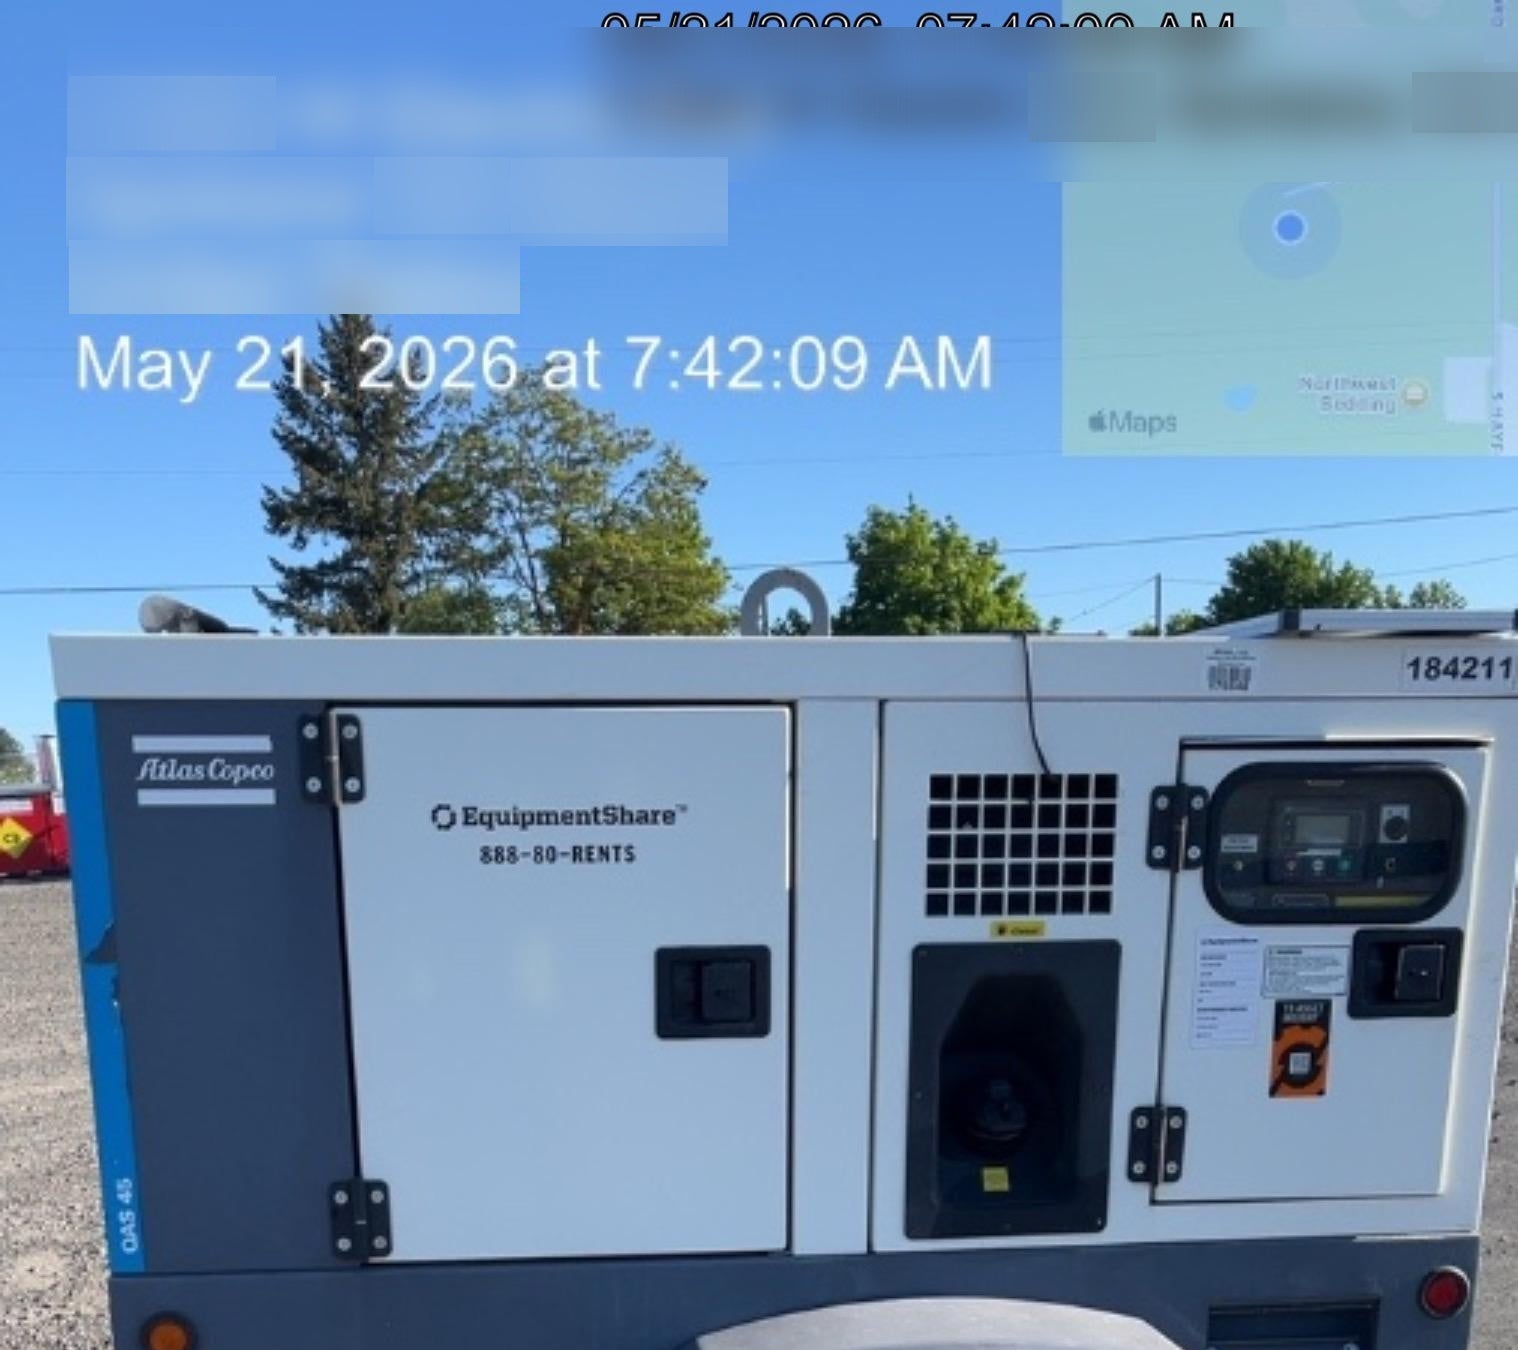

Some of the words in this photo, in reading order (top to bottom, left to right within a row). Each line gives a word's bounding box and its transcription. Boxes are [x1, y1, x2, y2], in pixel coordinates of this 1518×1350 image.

[1407, 655, 1513, 682] 184211
[136, 757, 205, 781] Atlas
[208, 757, 274, 786] Copco
[479, 845, 637, 864] 888-80-RENTS
[116, 1178, 133, 1204] 45
